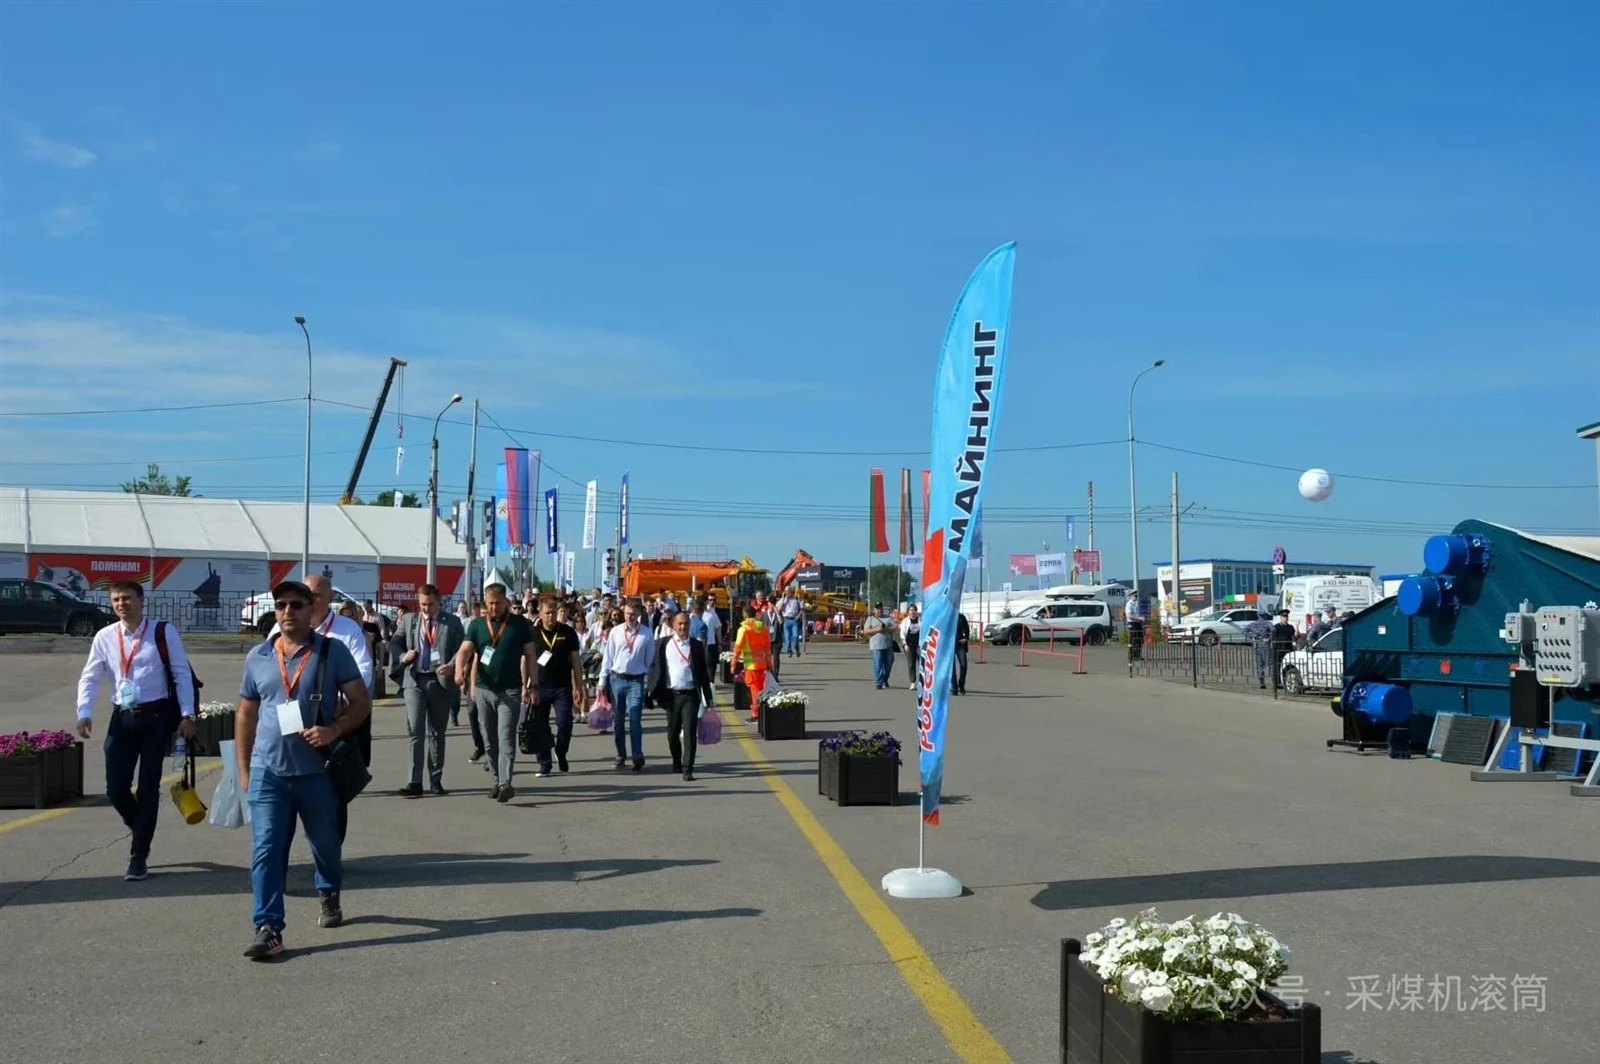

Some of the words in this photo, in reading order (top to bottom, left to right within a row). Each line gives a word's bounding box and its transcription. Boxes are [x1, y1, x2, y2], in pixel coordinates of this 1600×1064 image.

[948, 321, 997, 553] МАЙНИНГ
[91, 561, 140, 572] ПОМНИМ!
[382, 582, 415, 591] СПАСИБО
[920, 626, 939, 751] РОССИИ
